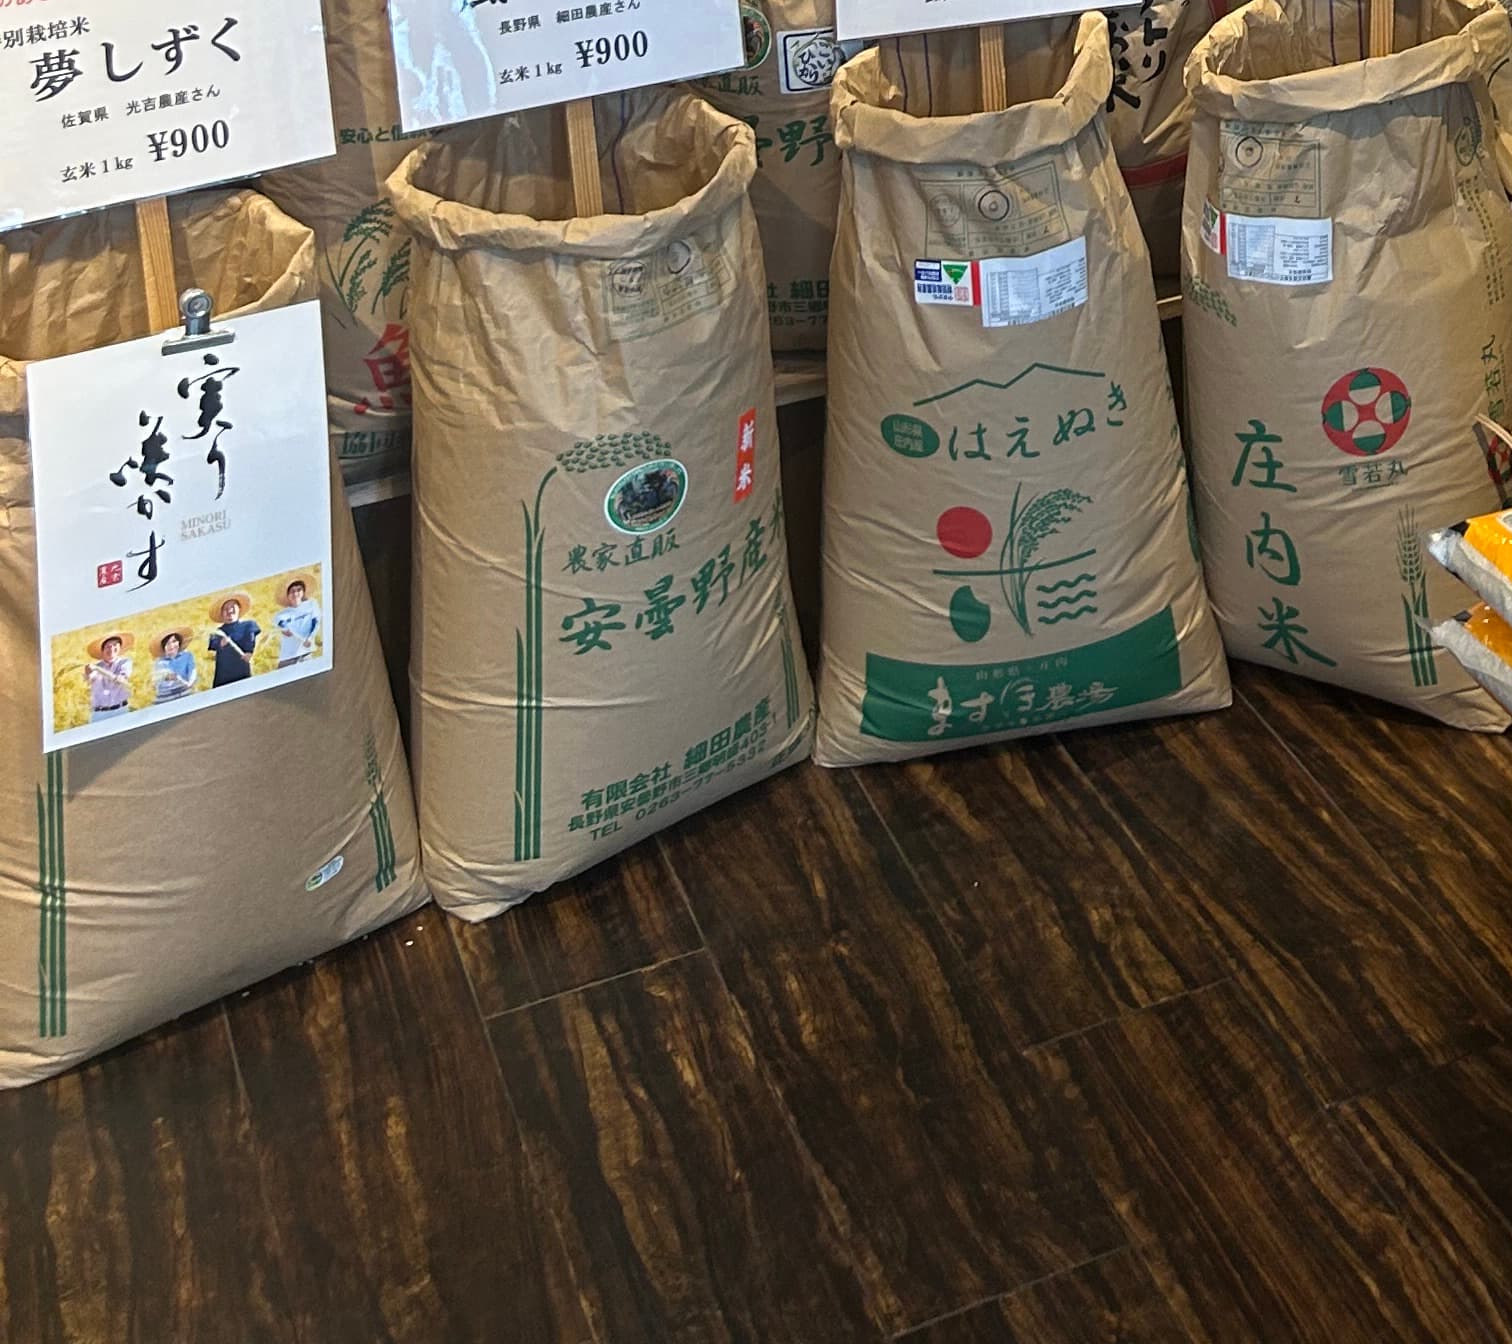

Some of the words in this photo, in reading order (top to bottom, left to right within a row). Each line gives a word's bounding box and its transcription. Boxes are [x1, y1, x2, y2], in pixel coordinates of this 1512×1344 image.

[499, 15, 542, 36] 長野県
[29, 17, 242, 103] 夢しずく
[575, 31, 648, 69] ¥900
[61, 107, 109, 129] 佐賀県
[126, 84, 221, 117] 光吉農産さん
[147, 119, 230, 162] ¥900
[949, 380, 1128, 460] はえぬき
[735, 418, 756, 494] 新米
[1338, 460, 1408, 487] 雪若丸
[180, 519, 231, 542] SAKASU
[181, 509, 227, 530] MINORI
[562, 528, 680, 574] 農家直販
[1231, 419, 1337, 669] 庄内米
[581, 761, 672, 811] 有限会社
[590, 821, 622, 841] TEL
